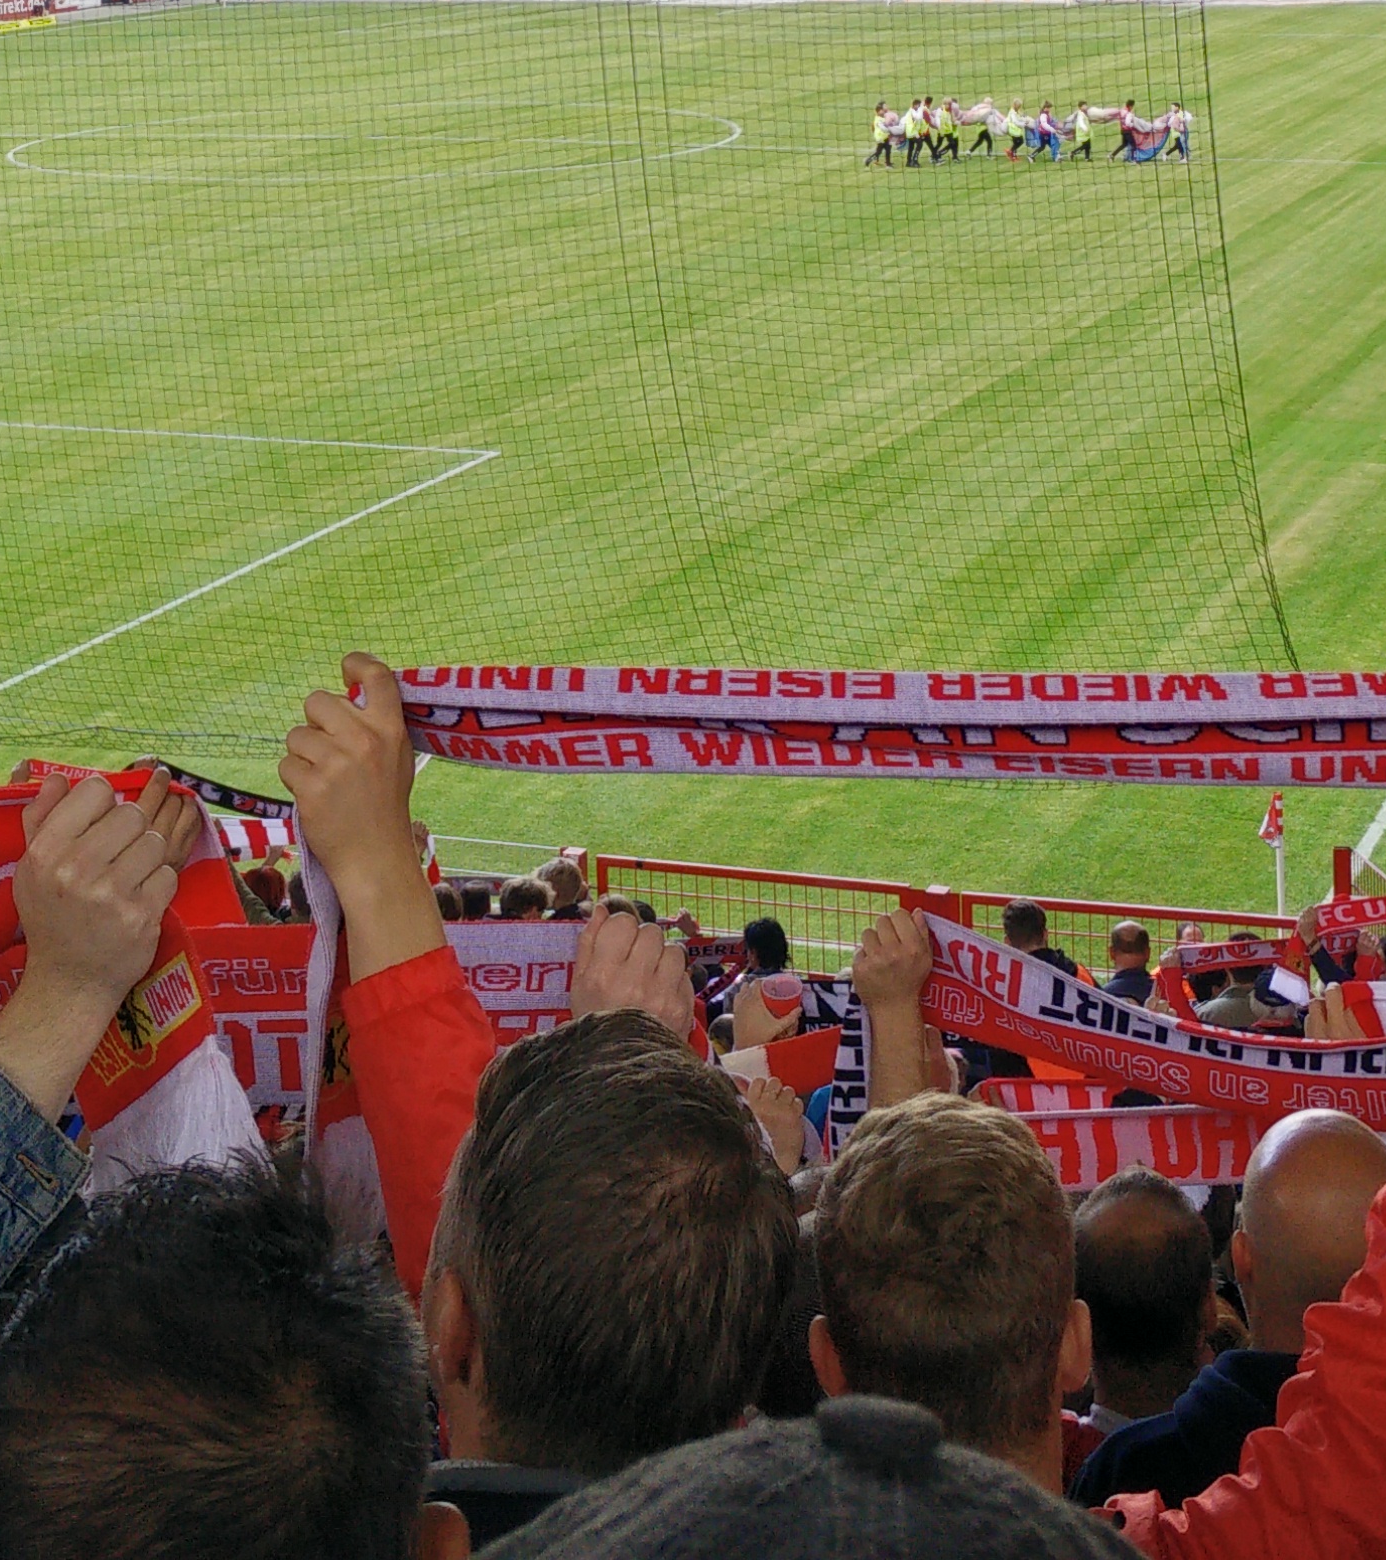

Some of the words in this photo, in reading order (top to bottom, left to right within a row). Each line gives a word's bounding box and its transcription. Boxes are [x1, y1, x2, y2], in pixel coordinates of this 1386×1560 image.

[401, 665, 585, 693] UNIO
[63, 767, 101, 779] UNIO
[425, 732, 653, 768] IMMER
[678, 732, 962, 769] WIEDER
[995, 753, 1260, 782] EISERN
[1317, 904, 1355, 928] FC
[143, 963, 196, 1028] UNION
[996, 1009, 1191, 1098] Schulter
[1209, 1072, 1269, 1106] an
